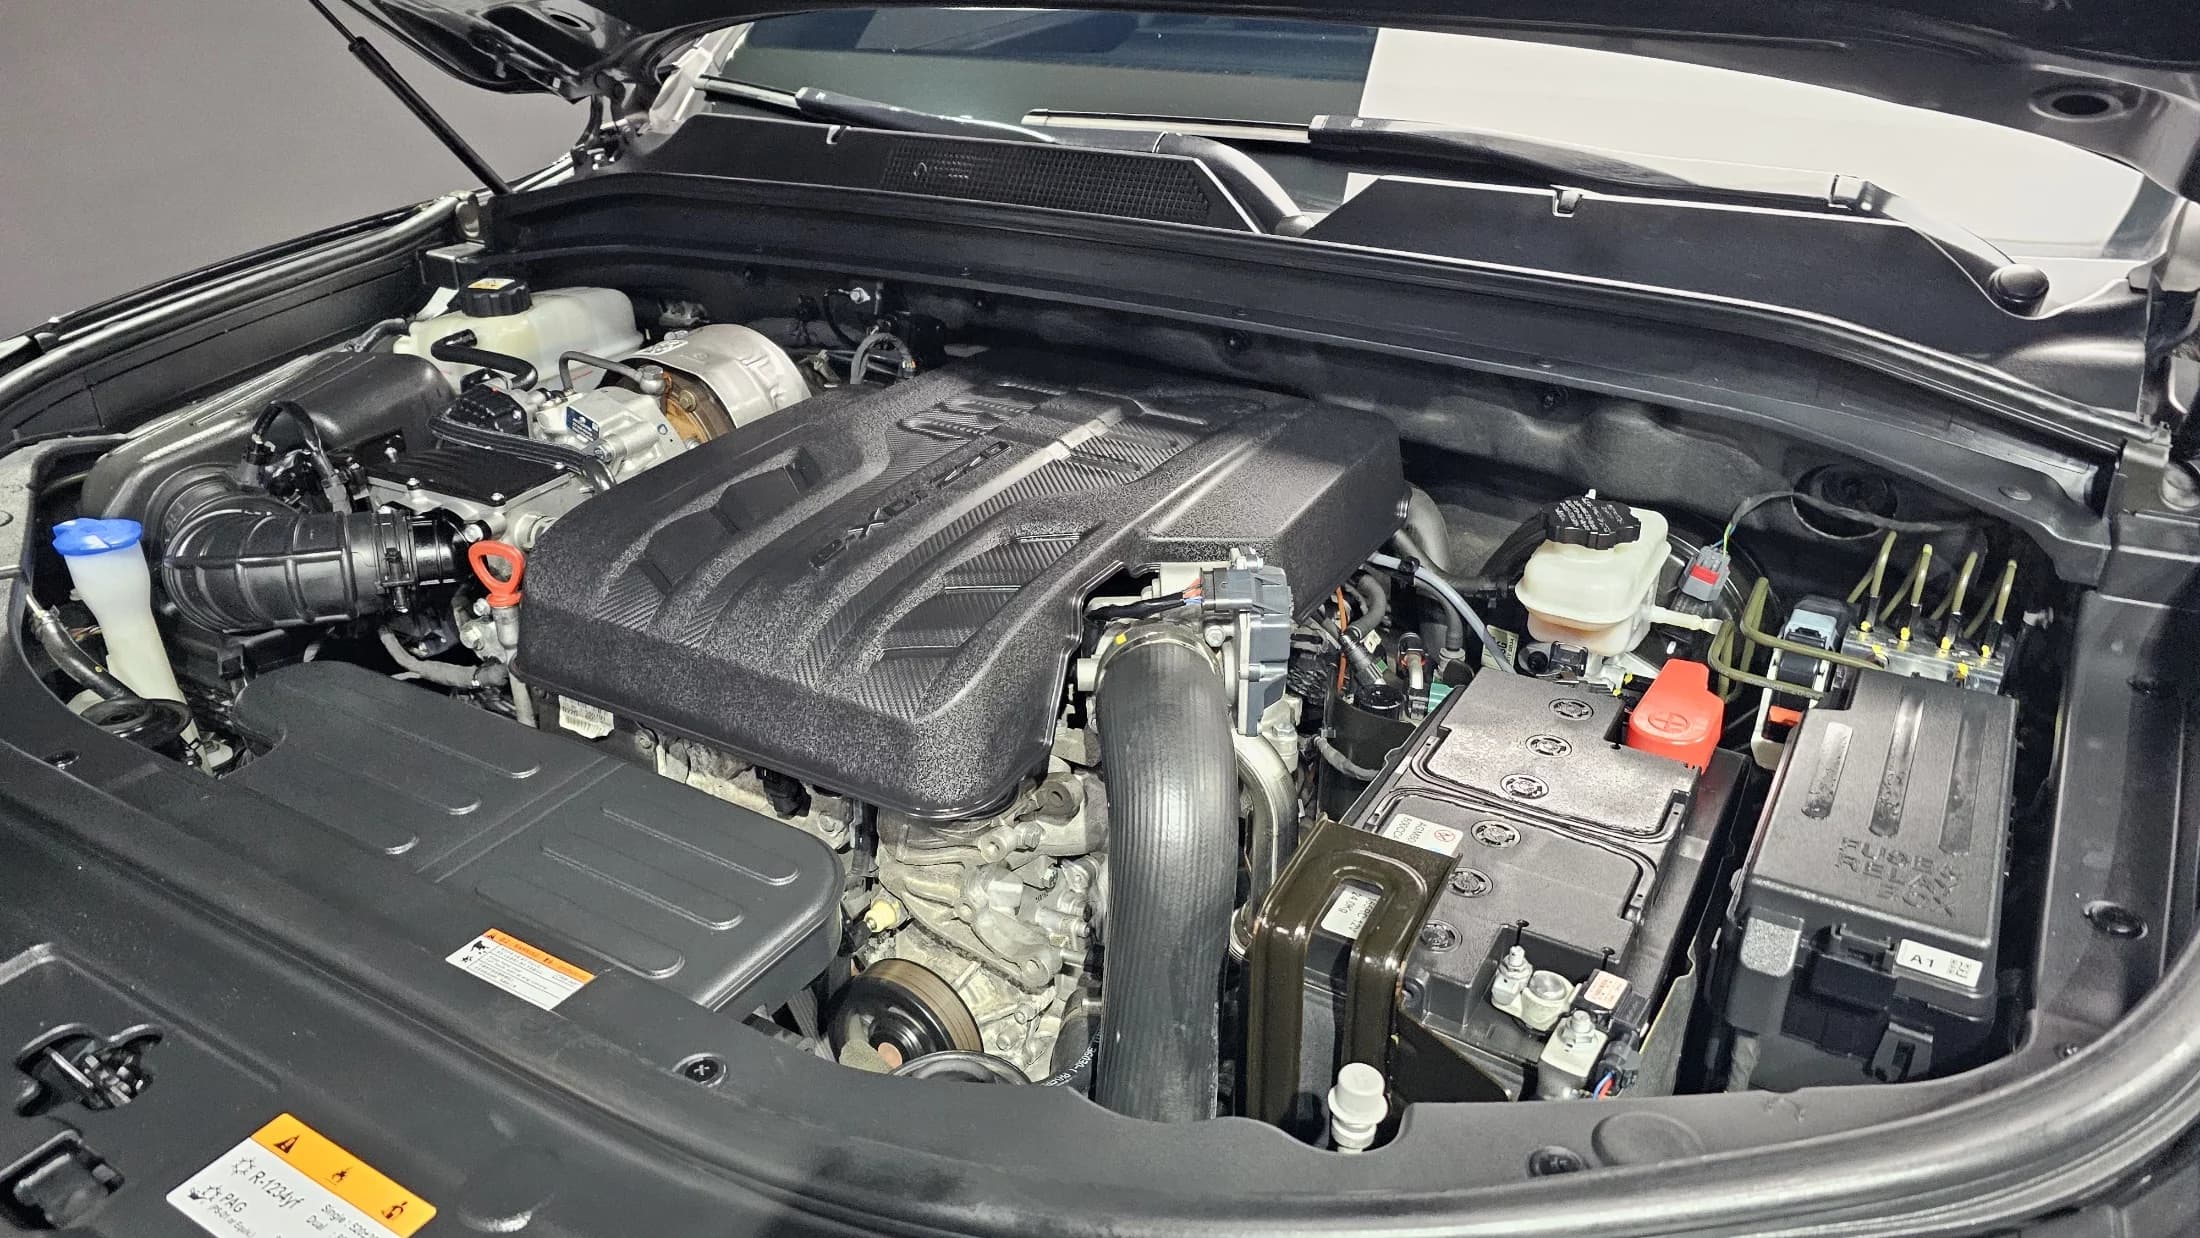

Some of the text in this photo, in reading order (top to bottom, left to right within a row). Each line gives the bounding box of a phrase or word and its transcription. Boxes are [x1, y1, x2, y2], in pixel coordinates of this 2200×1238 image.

[1910, 954, 1934, 968] A1
[249, 1170, 305, 1209] R-1234yf
[219, 1192, 248, 1214] PAG
